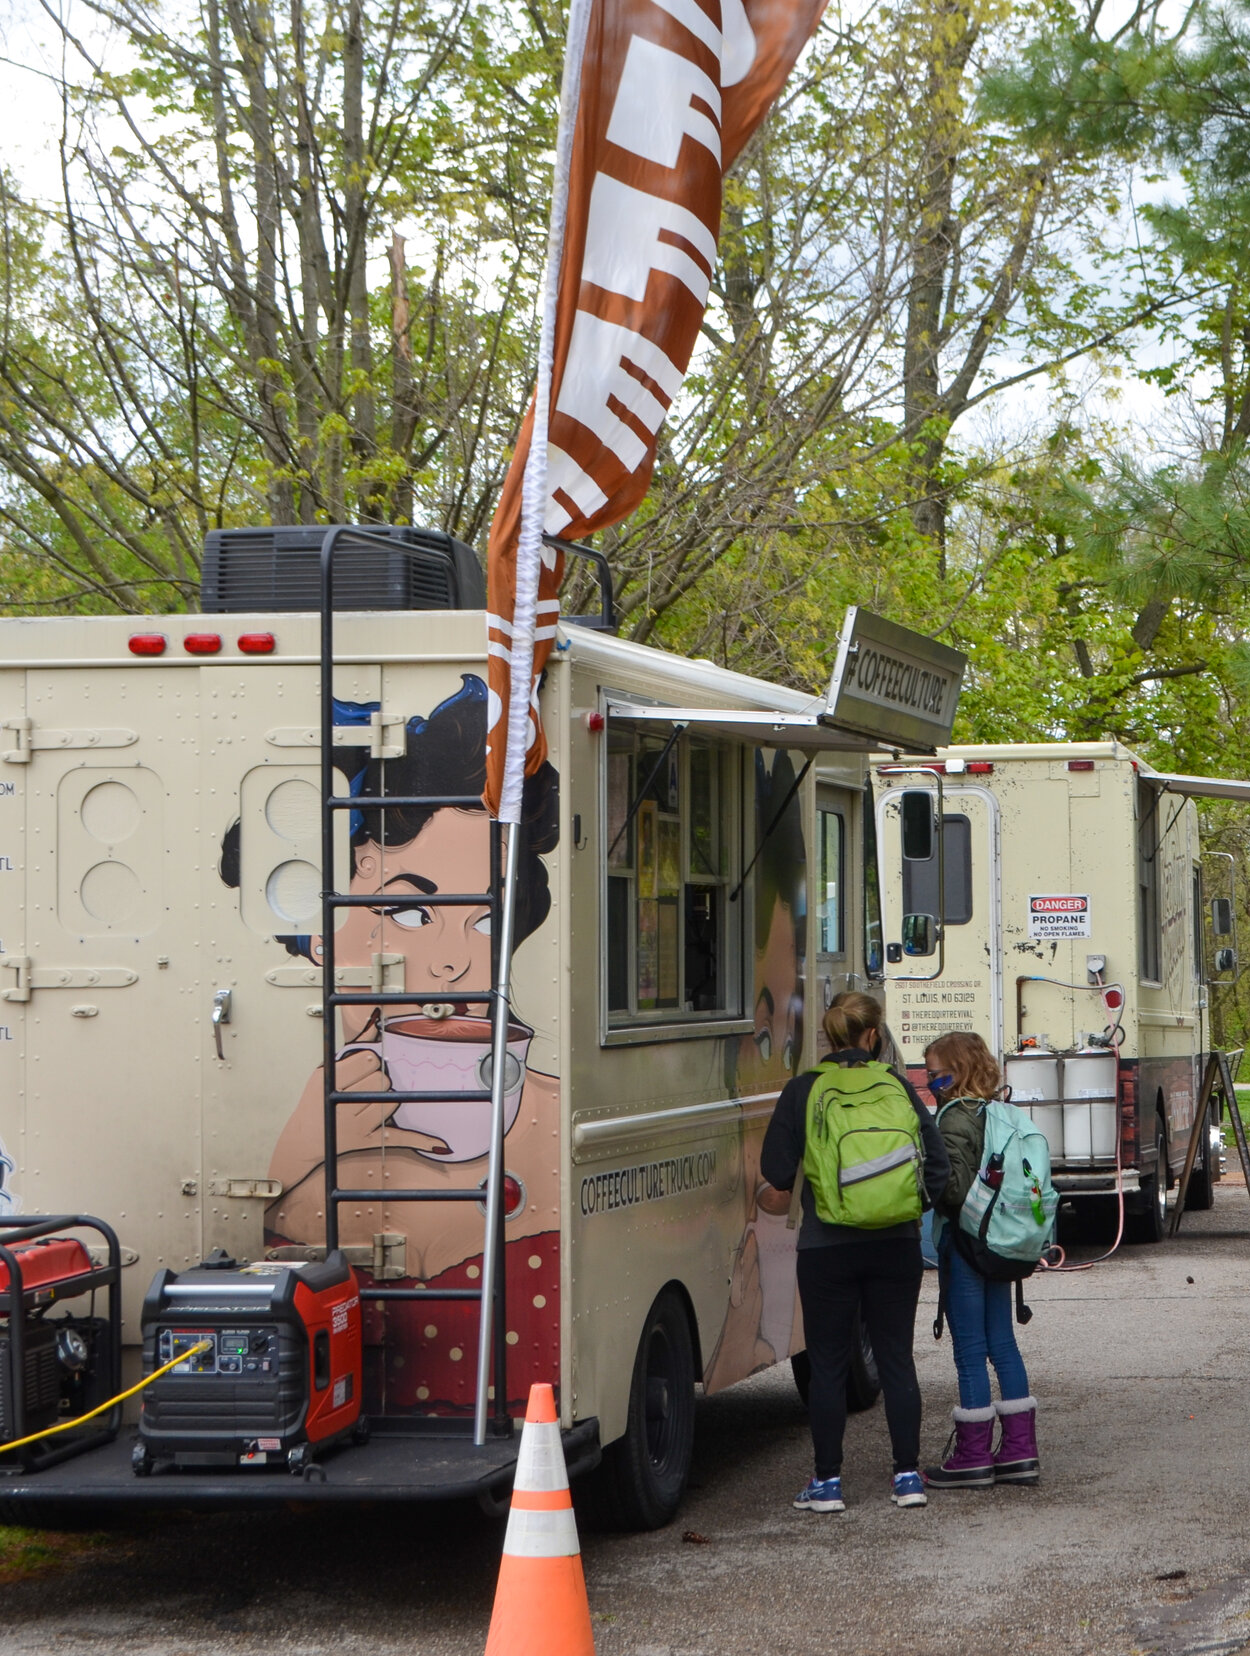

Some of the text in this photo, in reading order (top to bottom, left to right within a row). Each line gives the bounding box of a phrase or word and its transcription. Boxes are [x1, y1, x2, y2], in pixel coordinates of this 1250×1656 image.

[1035, 900, 1082, 910] DANGER
[1032, 915, 1086, 924] PROPANE
[902, 993, 914, 1003] ST.
[942, 993, 953, 1003] MO
[954, 992, 975, 1003] 63129
[580, 1150, 717, 1216] COFFEECULTURETRUCK.COM
